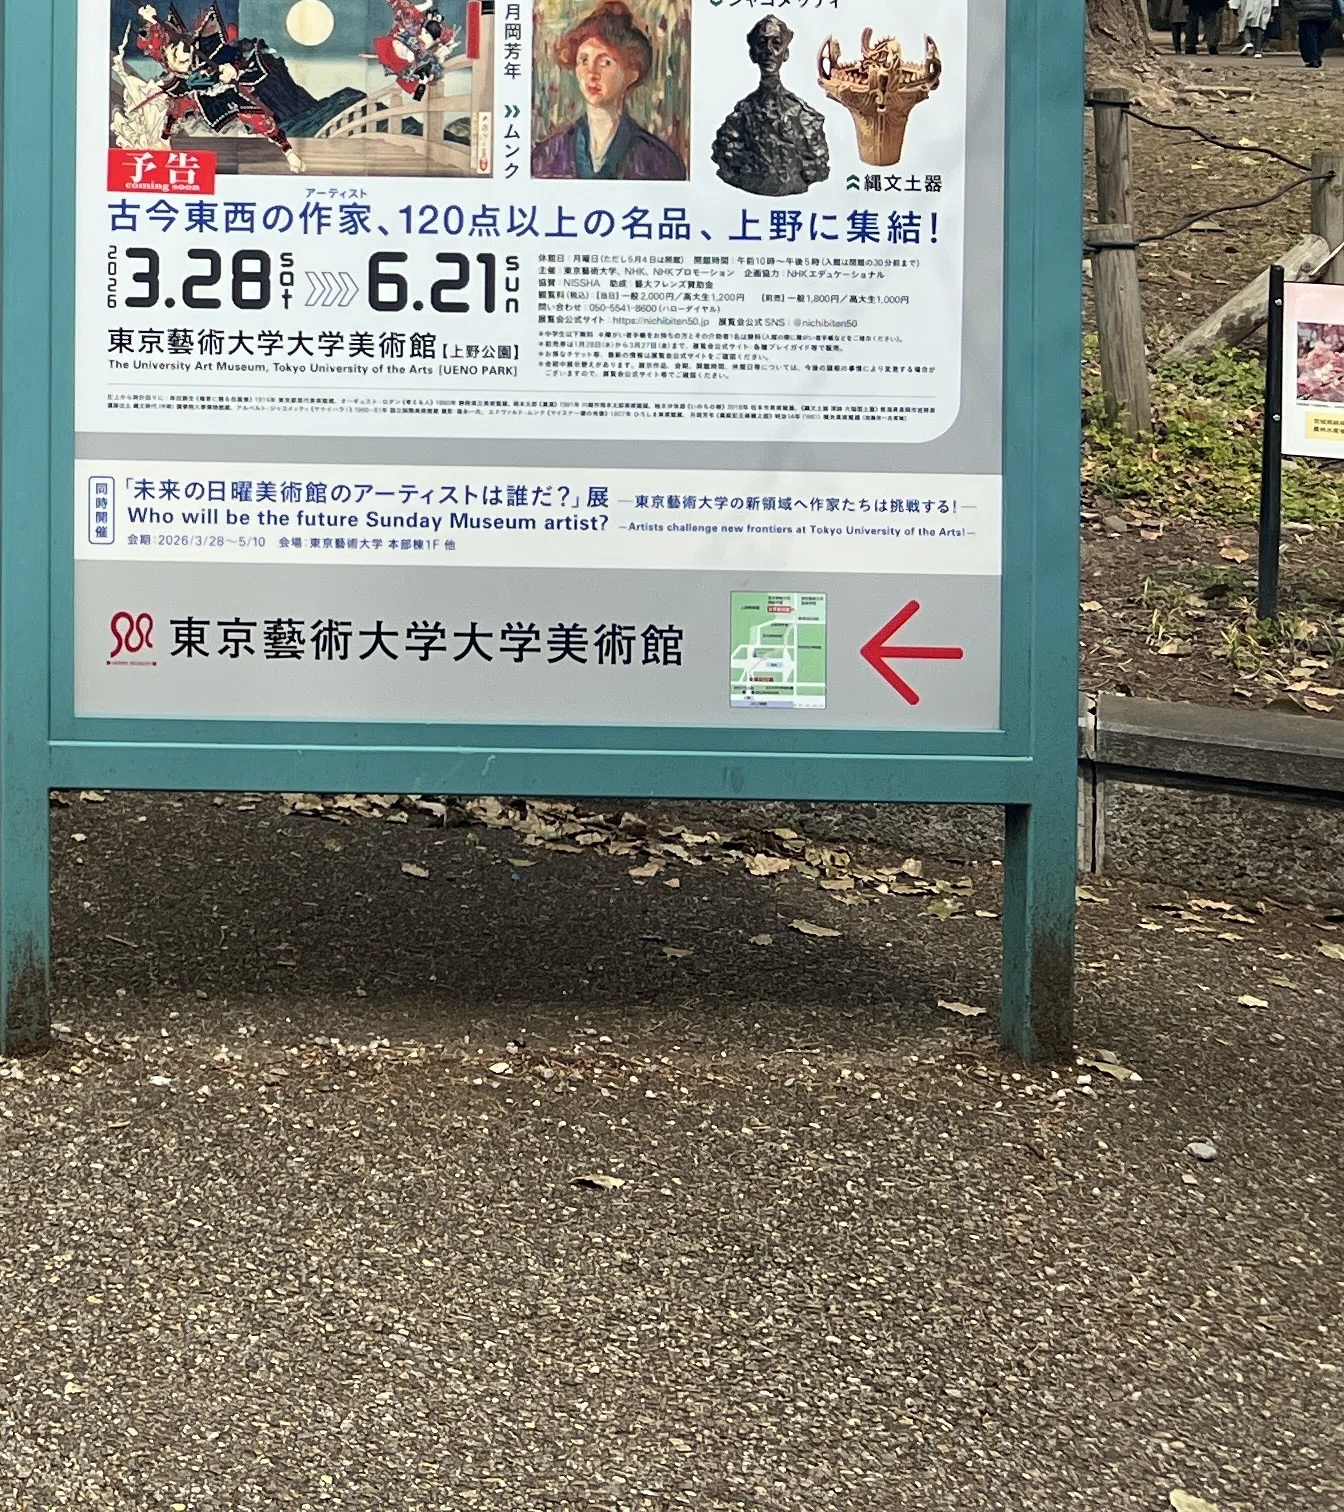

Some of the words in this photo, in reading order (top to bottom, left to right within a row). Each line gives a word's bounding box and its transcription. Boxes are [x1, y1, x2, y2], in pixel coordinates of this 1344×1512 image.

[504, 4, 522, 80] 月岡芳年
[121, 152, 201, 185] 予告
[504, 124, 522, 180] ムンク
[125, 180, 170, 192] coming
[305, 188, 368, 199] アーティスト
[107, 245, 117, 309] 2026
[124, 247, 271, 310] 3.28
[280, 252, 294, 309] sat
[368, 251, 495, 314] 6.21
[505, 254, 520, 314] sun
[108, 328, 437, 361] 東京藝術大学大学美術館
[108, 359, 129, 369] The
[133, 360, 191, 373] University
[195, 361, 213, 371] Art
[216, 361, 270, 373] Museum,
[273, 362, 306, 374] Tokyo
[310, 363, 368, 376] University
[372, 364, 384, 374] of
[386, 364, 406, 374] the
[409, 365, 433, 375] Arts
[95, 482, 108, 538] 同時開催
[127, 507, 174, 524] Who
[182, 508, 218, 525] will
[226, 509, 250, 525] be
[257, 510, 289, 526] the
[297, 510, 358, 527] future
[366, 511, 442, 532] Sunday
[450, 512, 536, 530] Museum
[544, 515, 609, 532] artist?
[667, 523, 718, 534] challenge
[721, 524, 743, 533] new
[746, 523, 792, 534] frontiers
[796, 525, 806, 534] at
[810, 525, 842, 536] Tokyo
[846, 526, 901, 537] University
[904, 526, 916, 536] of
[918, 527, 936, 536] the
[170, 616, 684, 666] 東京藝術大学大学美術館
